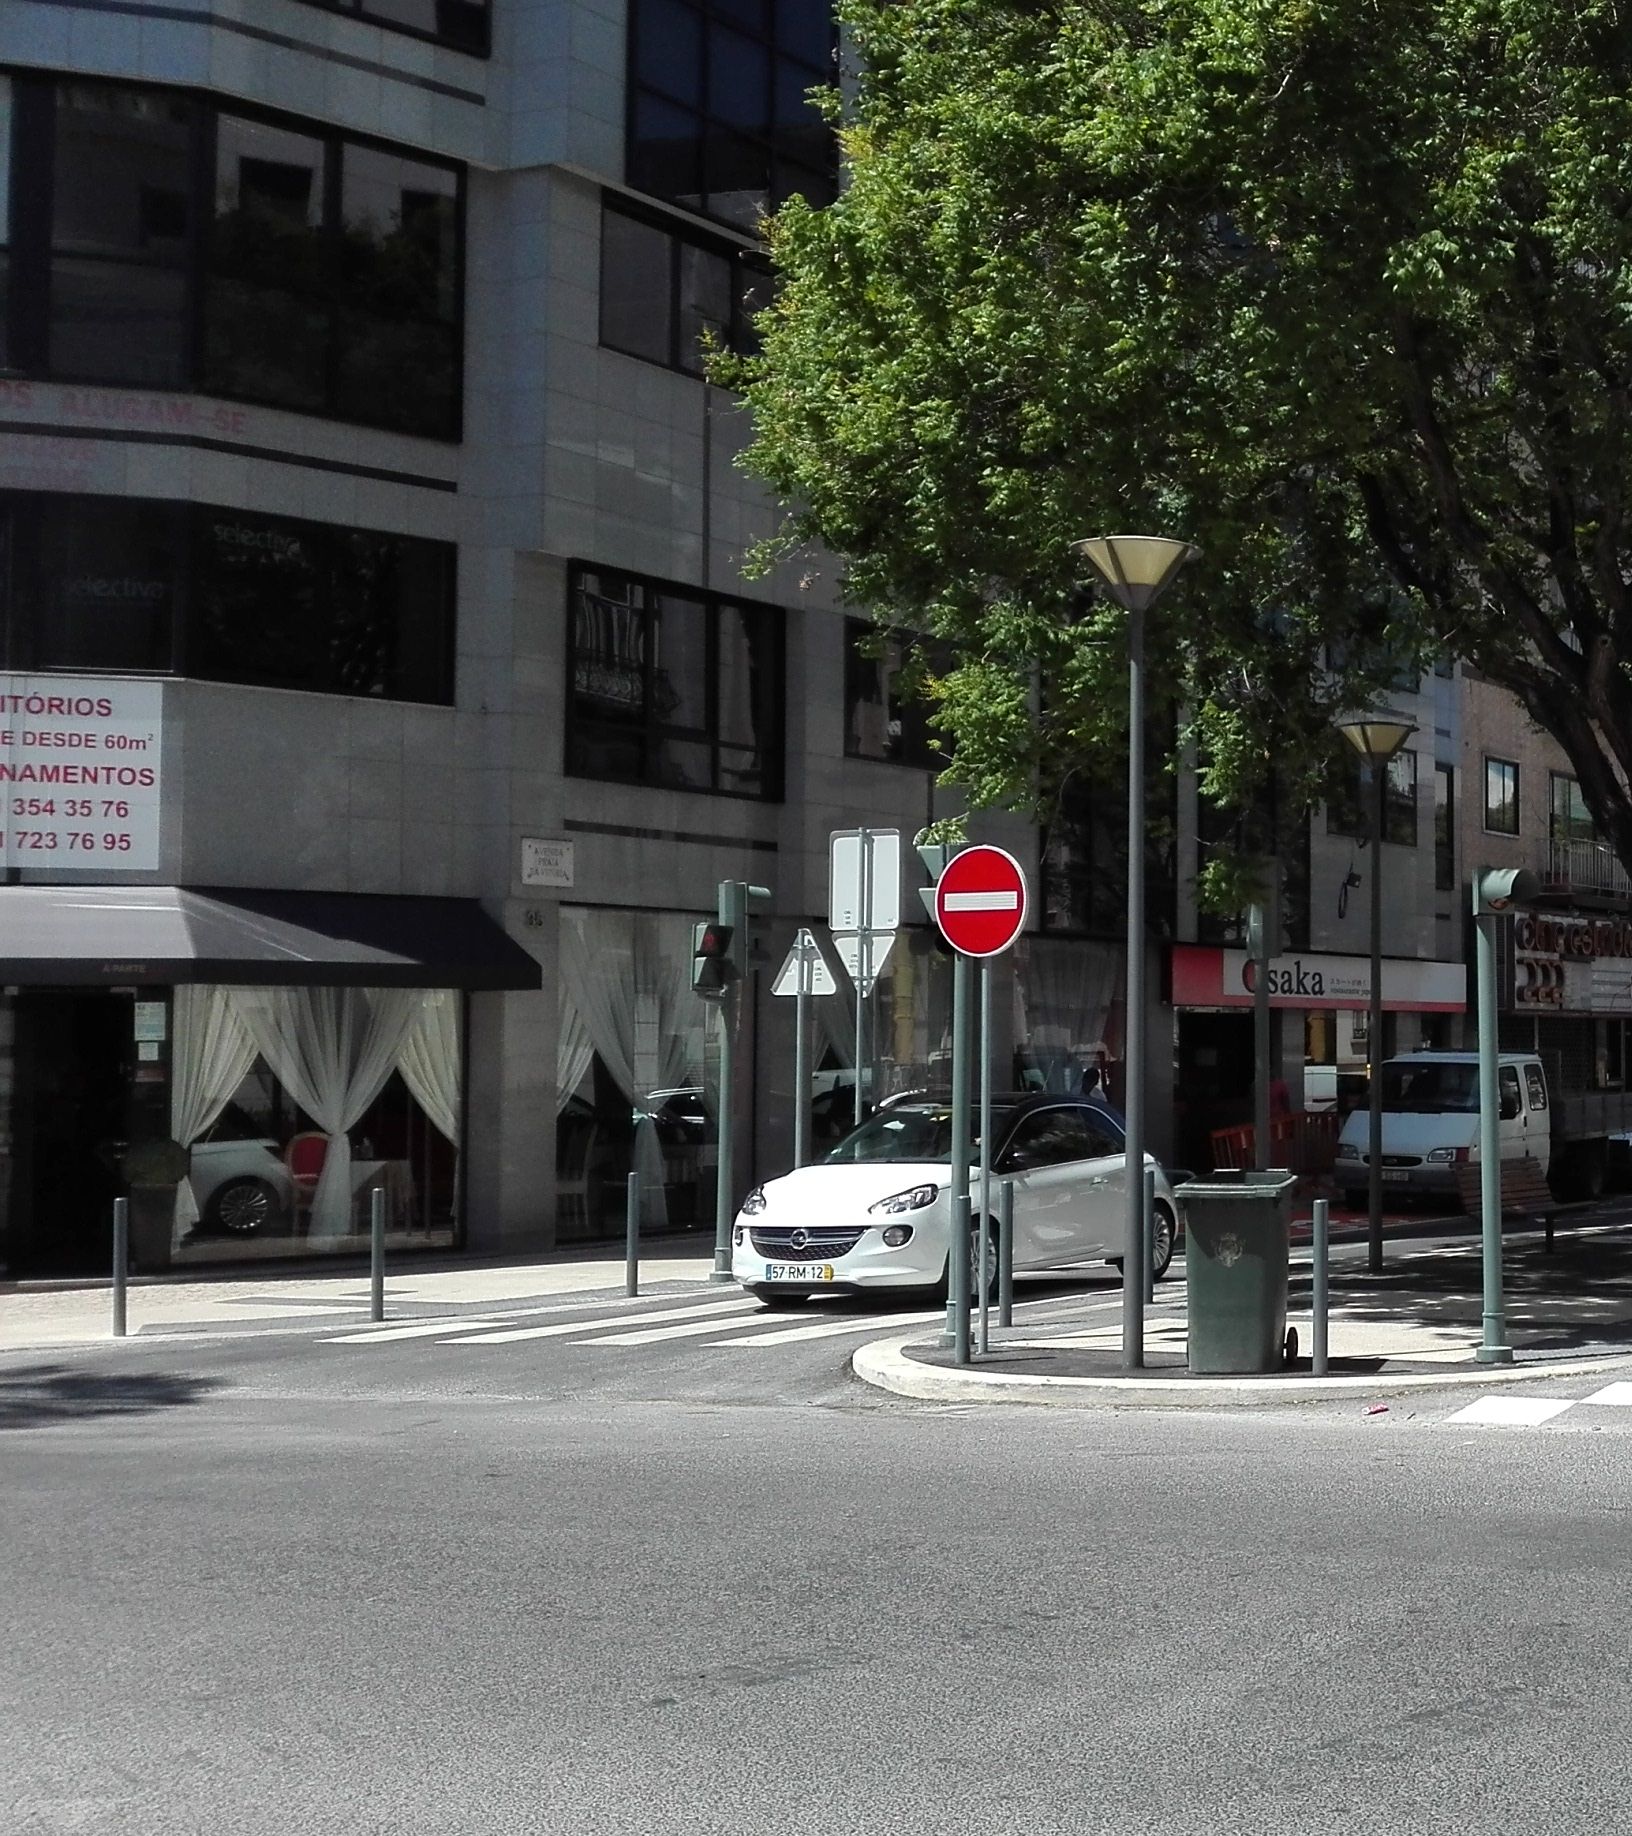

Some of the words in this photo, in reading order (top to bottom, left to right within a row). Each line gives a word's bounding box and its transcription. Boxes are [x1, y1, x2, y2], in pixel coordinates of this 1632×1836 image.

[22, 731, 97, 748] DESDE
[0, 764, 155, 786] NAMENTOS
[13, 798, 55, 816] 354
[64, 800, 92, 817] 35
[102, 801, 128, 818] 76
[16, 832, 57, 849] 723
[67, 833, 94, 850] 76
[103, 834, 131, 851] 95
